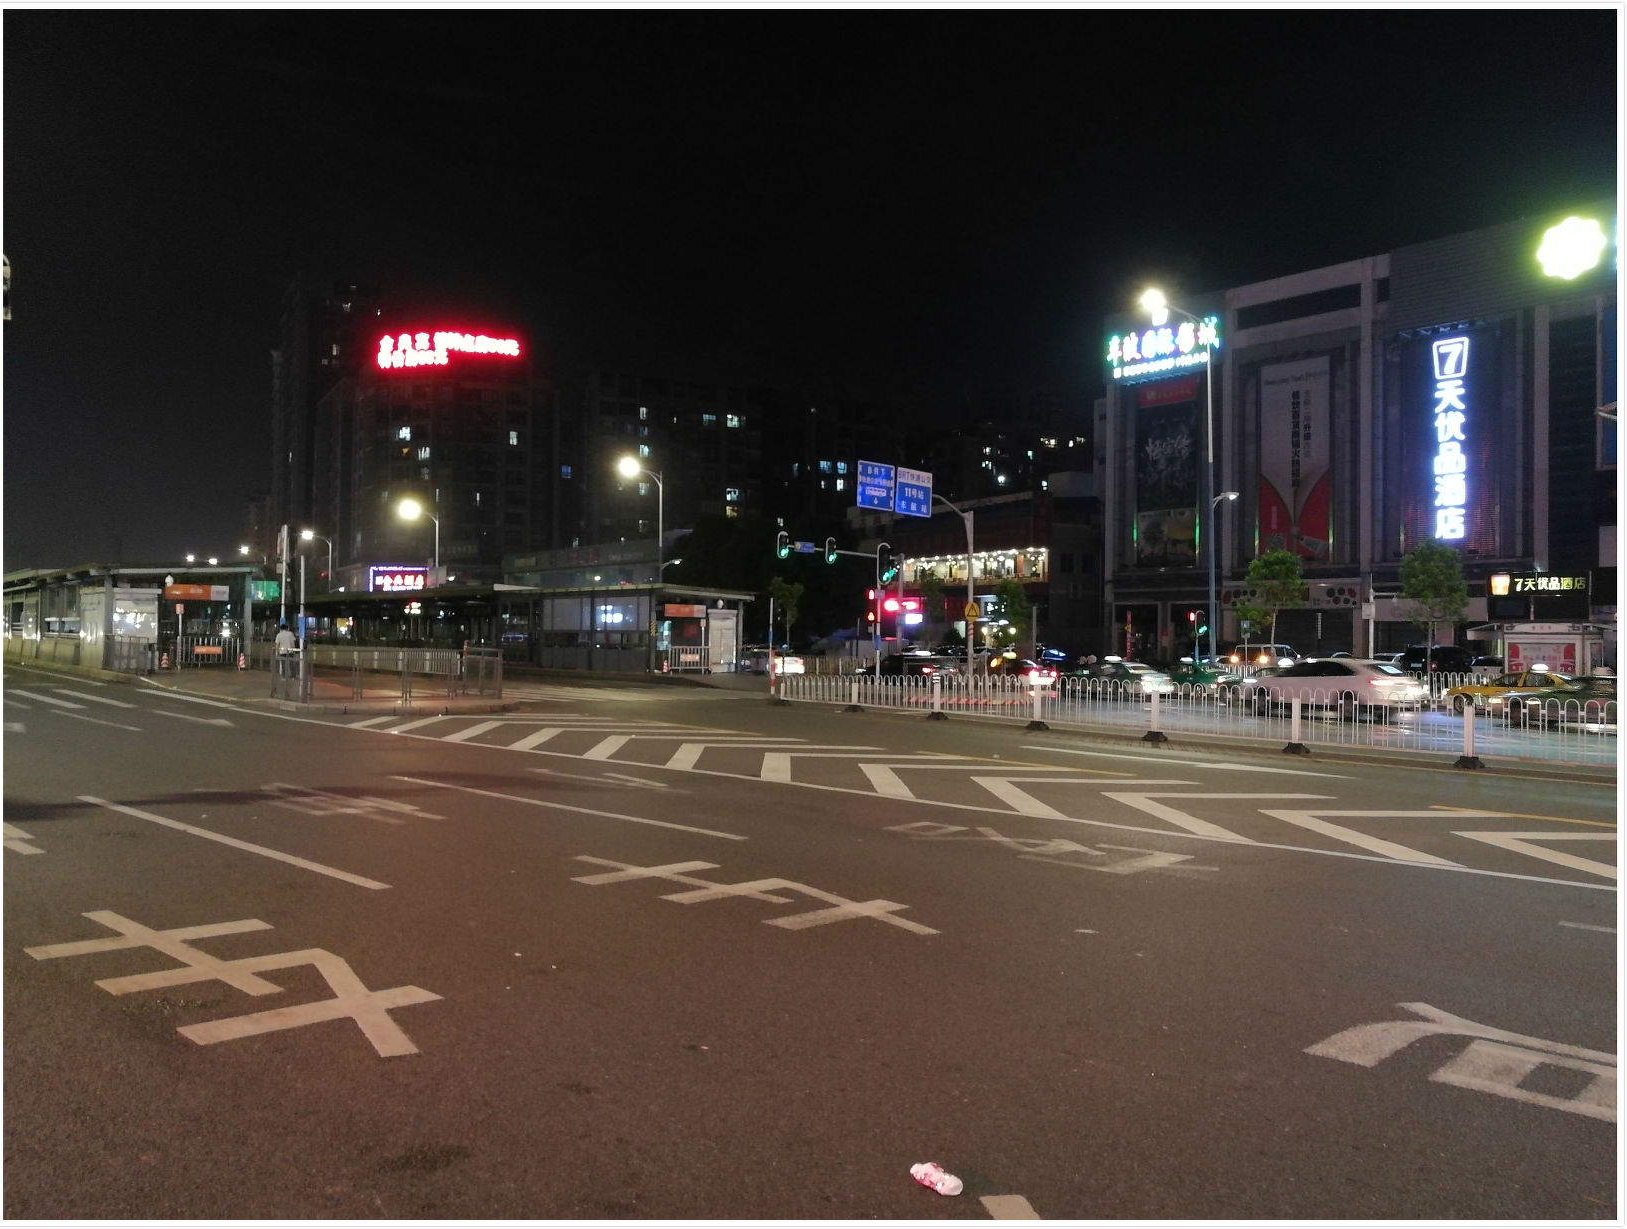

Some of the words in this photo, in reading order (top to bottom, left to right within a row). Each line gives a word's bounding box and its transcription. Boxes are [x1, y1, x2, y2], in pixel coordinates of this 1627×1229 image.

[1514, 576, 1587, 592] 7天优品酒店
